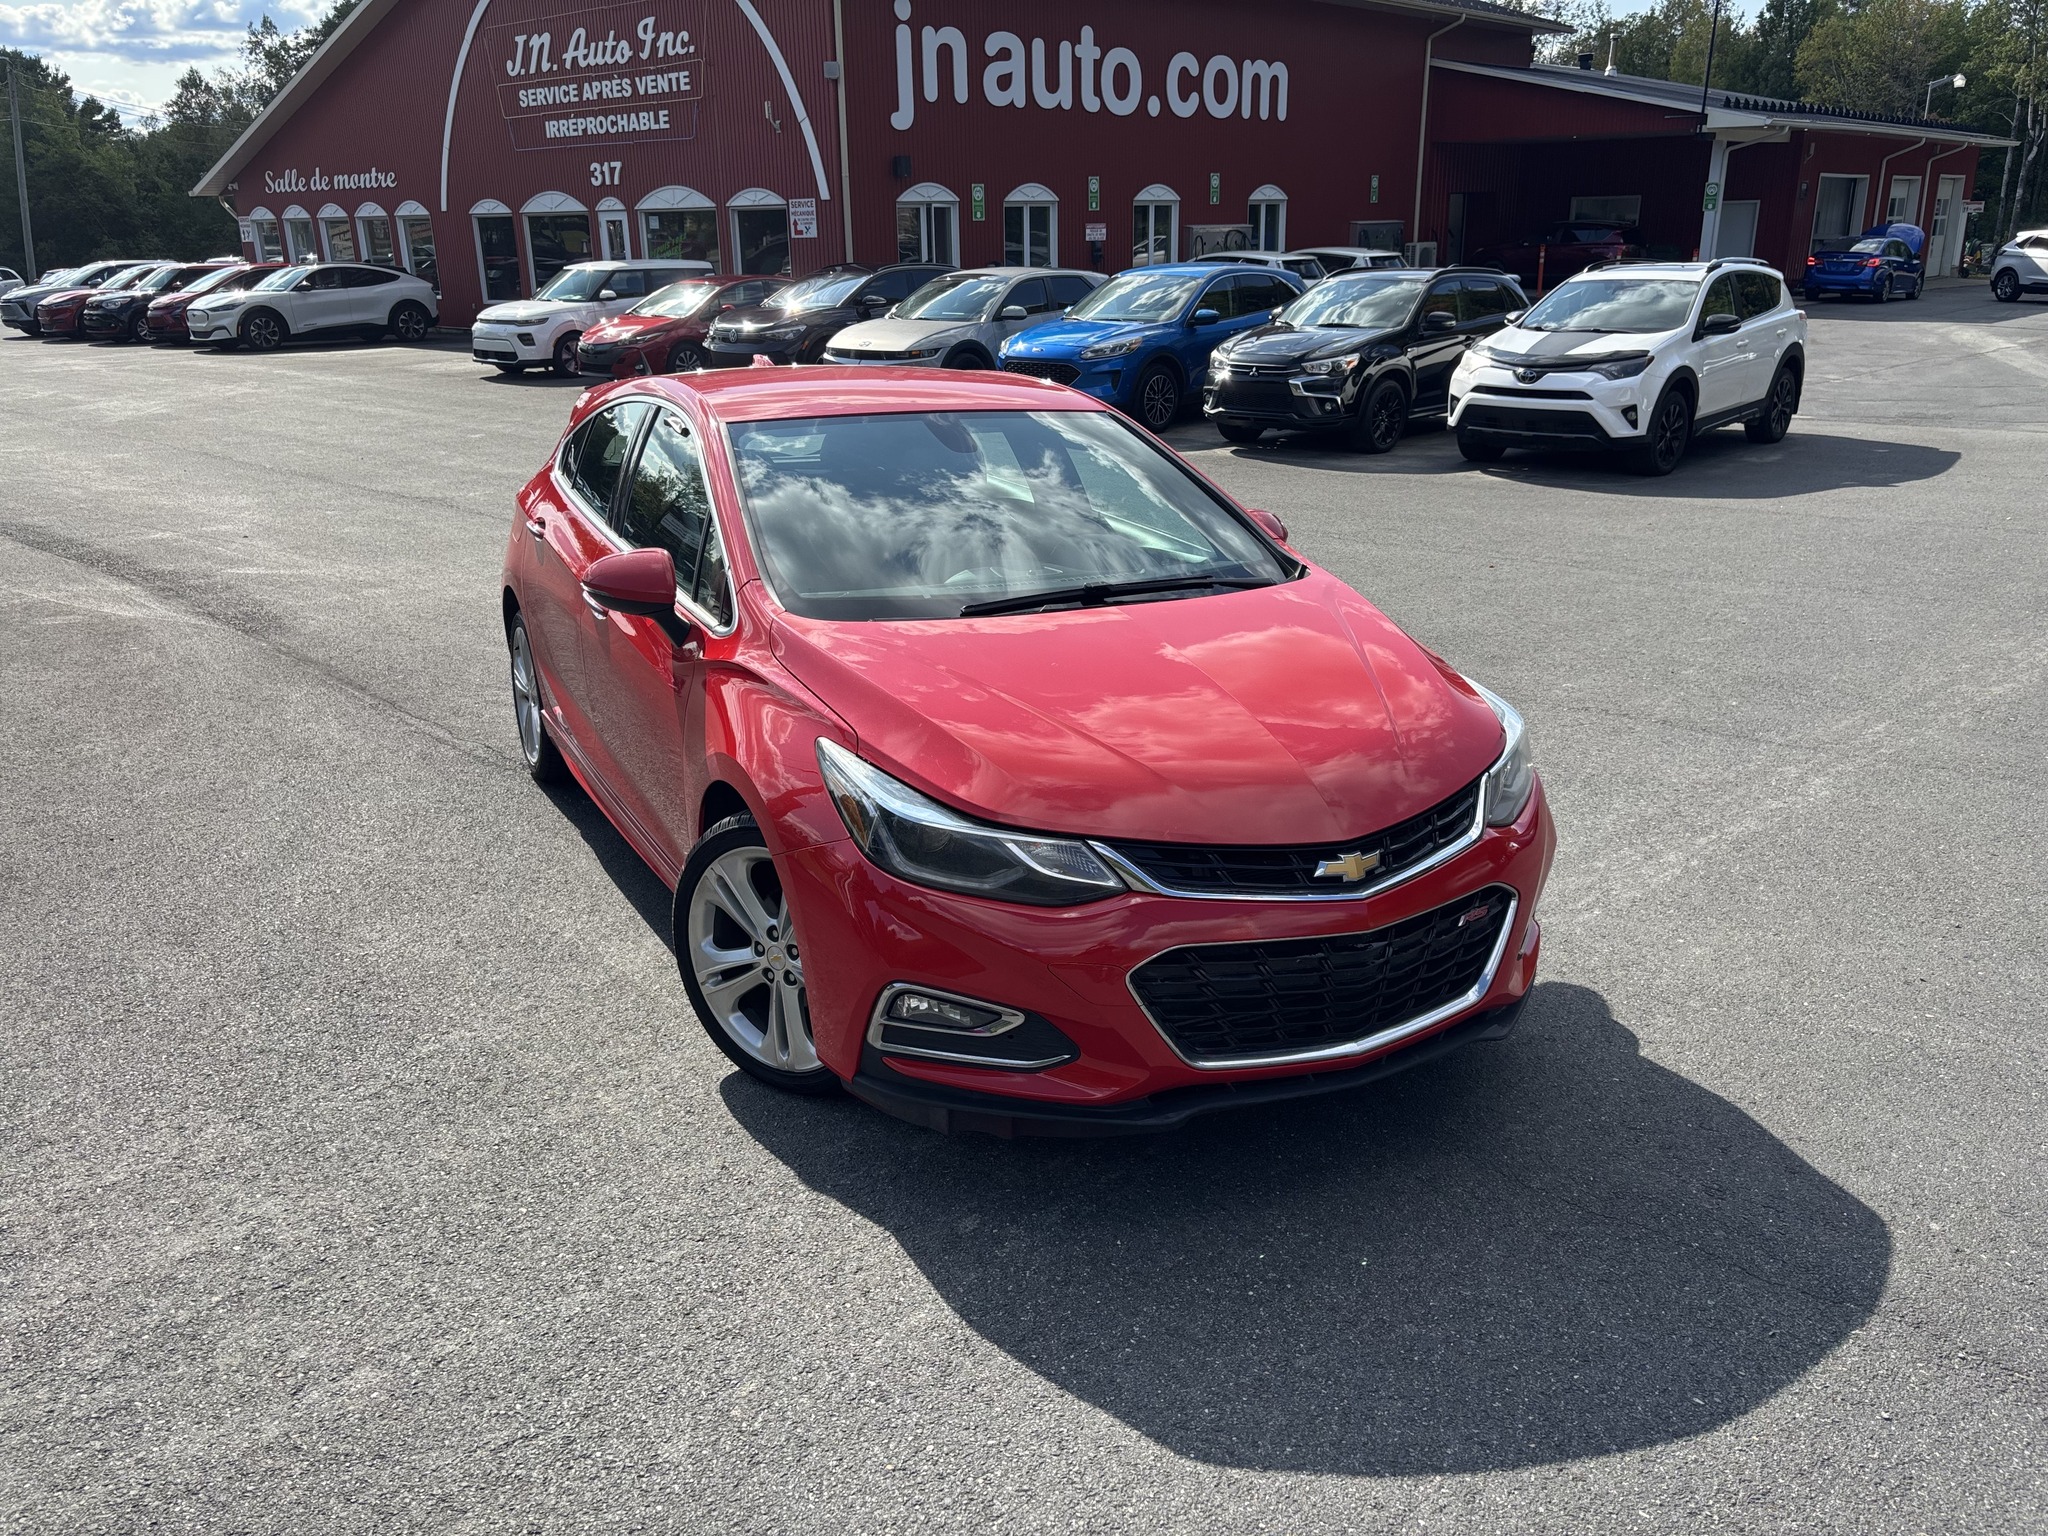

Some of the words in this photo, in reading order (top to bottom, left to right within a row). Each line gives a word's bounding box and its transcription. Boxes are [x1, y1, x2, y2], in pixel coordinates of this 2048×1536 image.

[562, 26, 633, 70] Auto
[637, 16, 696, 60] Inc.
[518, 84, 579, 108] SERVICE
[582, 74, 633, 101] APRÈS
[635, 71, 692, 96] VENTE
[545, 110, 671, 139] IRRÉPROCHABLE
[264, 168, 308, 194] Salle
[310, 167, 331, 192] de
[333, 167, 398, 190] montre
[589, 161, 623, 187] 317
[790, 200, 815, 209] SERVICE
